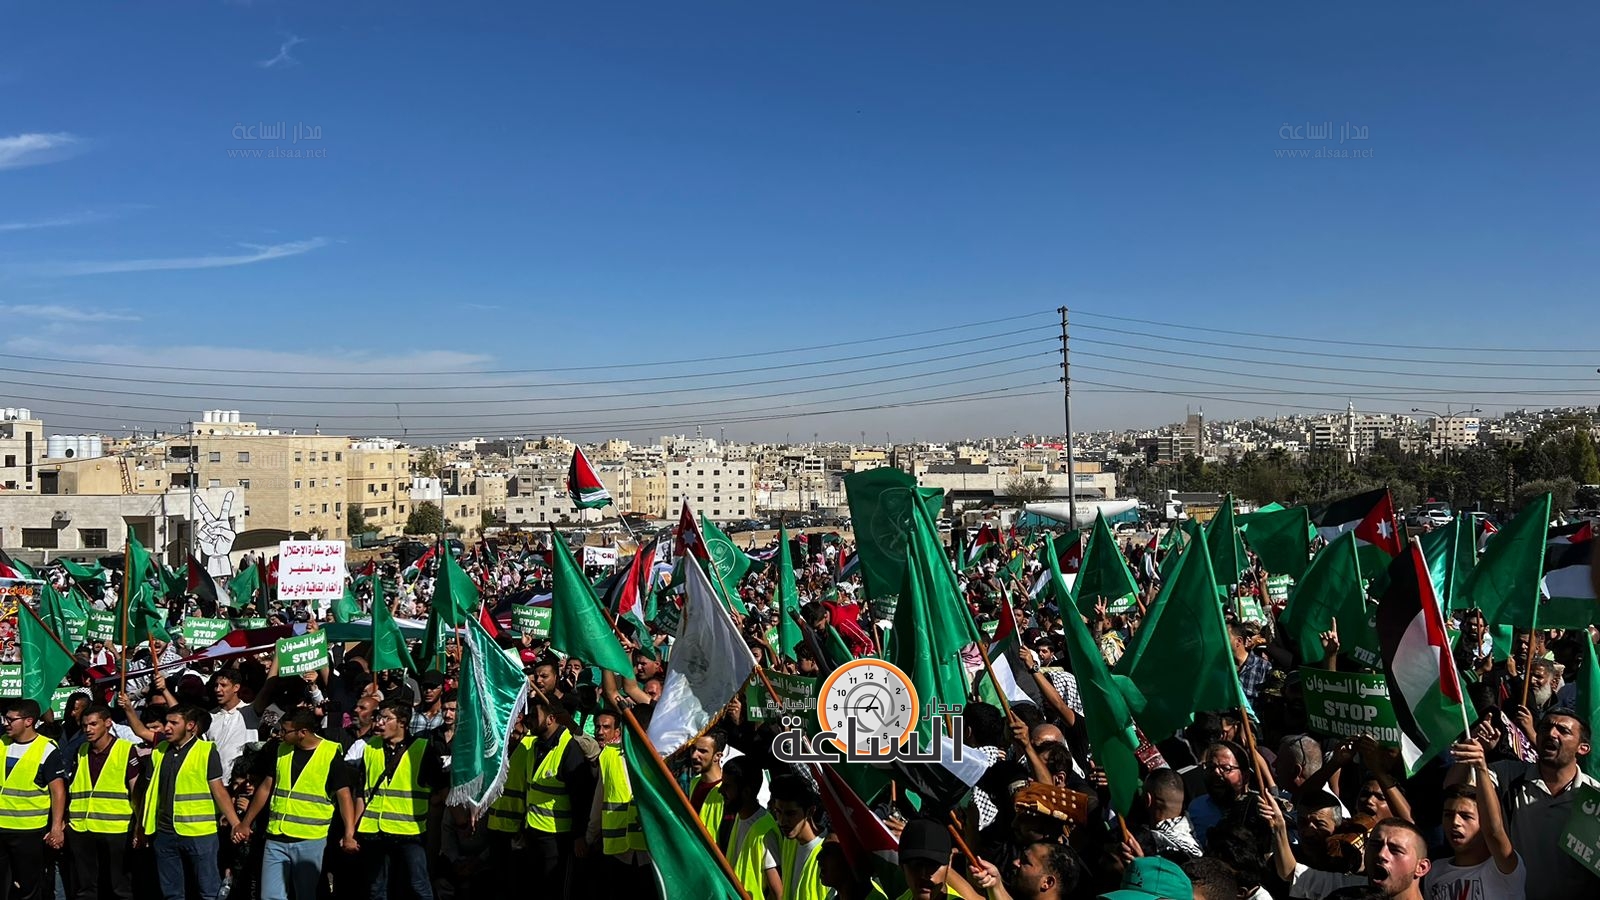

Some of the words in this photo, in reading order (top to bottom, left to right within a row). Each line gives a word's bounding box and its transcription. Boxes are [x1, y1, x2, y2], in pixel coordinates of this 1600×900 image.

[308, 545, 324, 557] سفارة
[289, 562, 316, 575] السفير
[519, 618, 540, 627] STOP
[193, 630, 217, 639] STOP
[292, 649, 320, 663] STOP
[1354, 646, 1376, 665] THE
[281, 665, 295, 674] THE
[1305, 674, 1353, 694] العدوان
[1323, 700, 1378, 722] STOP
[1310, 714, 1329, 731] THE
[1566, 832, 1594, 863] THE
